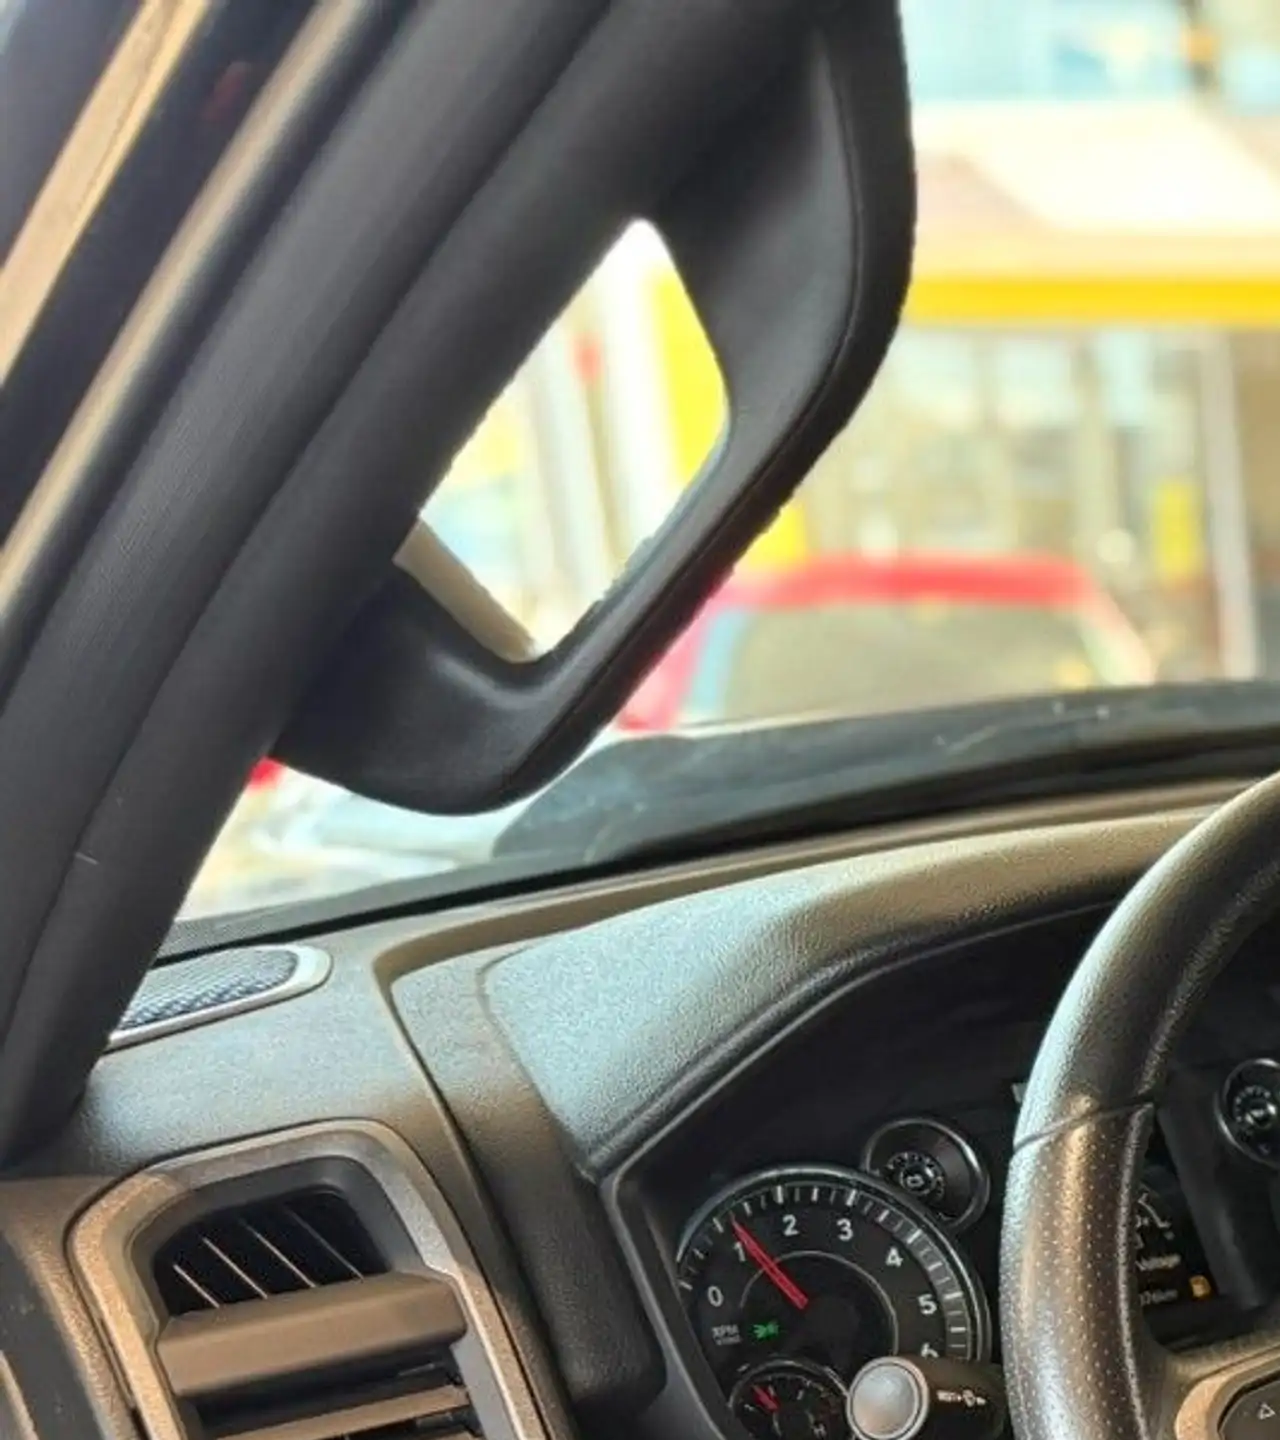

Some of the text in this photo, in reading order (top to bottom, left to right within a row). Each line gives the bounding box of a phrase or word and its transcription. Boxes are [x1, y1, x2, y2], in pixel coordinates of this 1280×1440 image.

[782, 1214, 799, 1236] 2
[836, 1218, 854, 1241] 3
[733, 1242, 747, 1262] 1
[885, 1247, 904, 1268] 4
[707, 1285, 724, 1307] 0
[917, 1293, 937, 1315] 5
